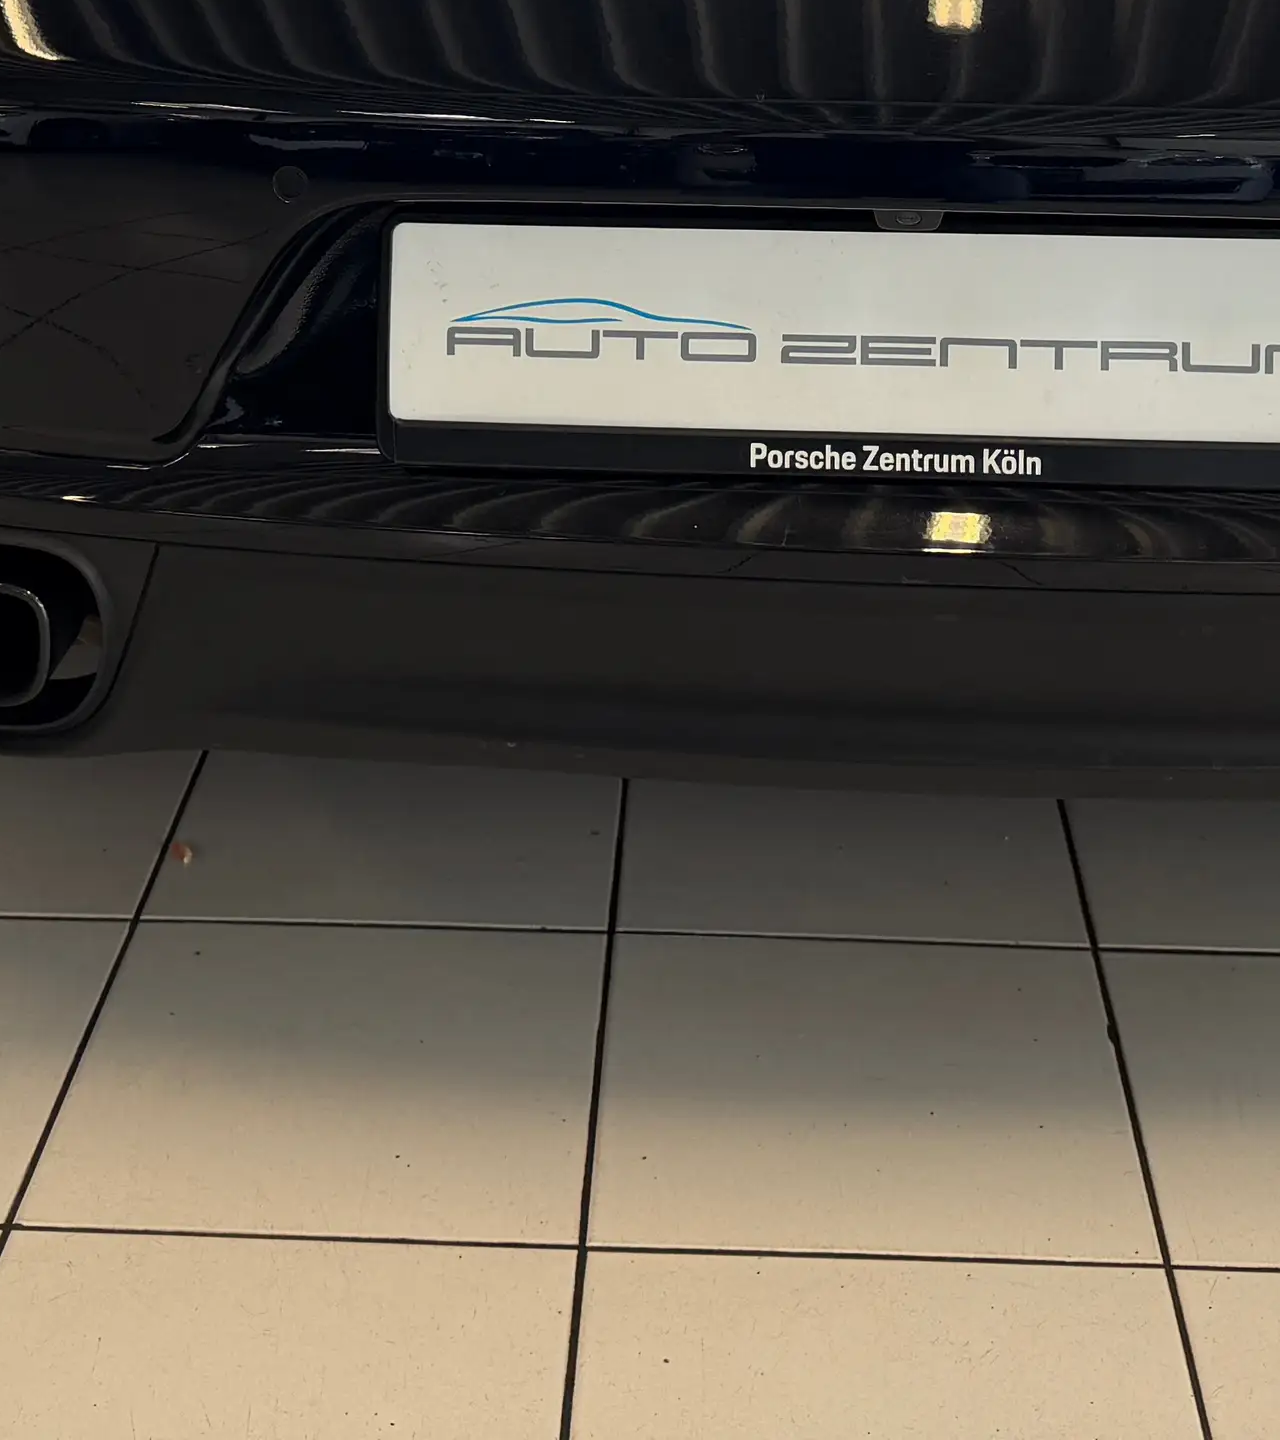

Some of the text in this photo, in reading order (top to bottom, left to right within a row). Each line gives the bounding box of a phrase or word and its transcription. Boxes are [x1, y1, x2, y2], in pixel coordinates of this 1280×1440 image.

[446, 326, 758, 364] AUTO
[749, 442, 1042, 476] Porsche Zentrum Köln
